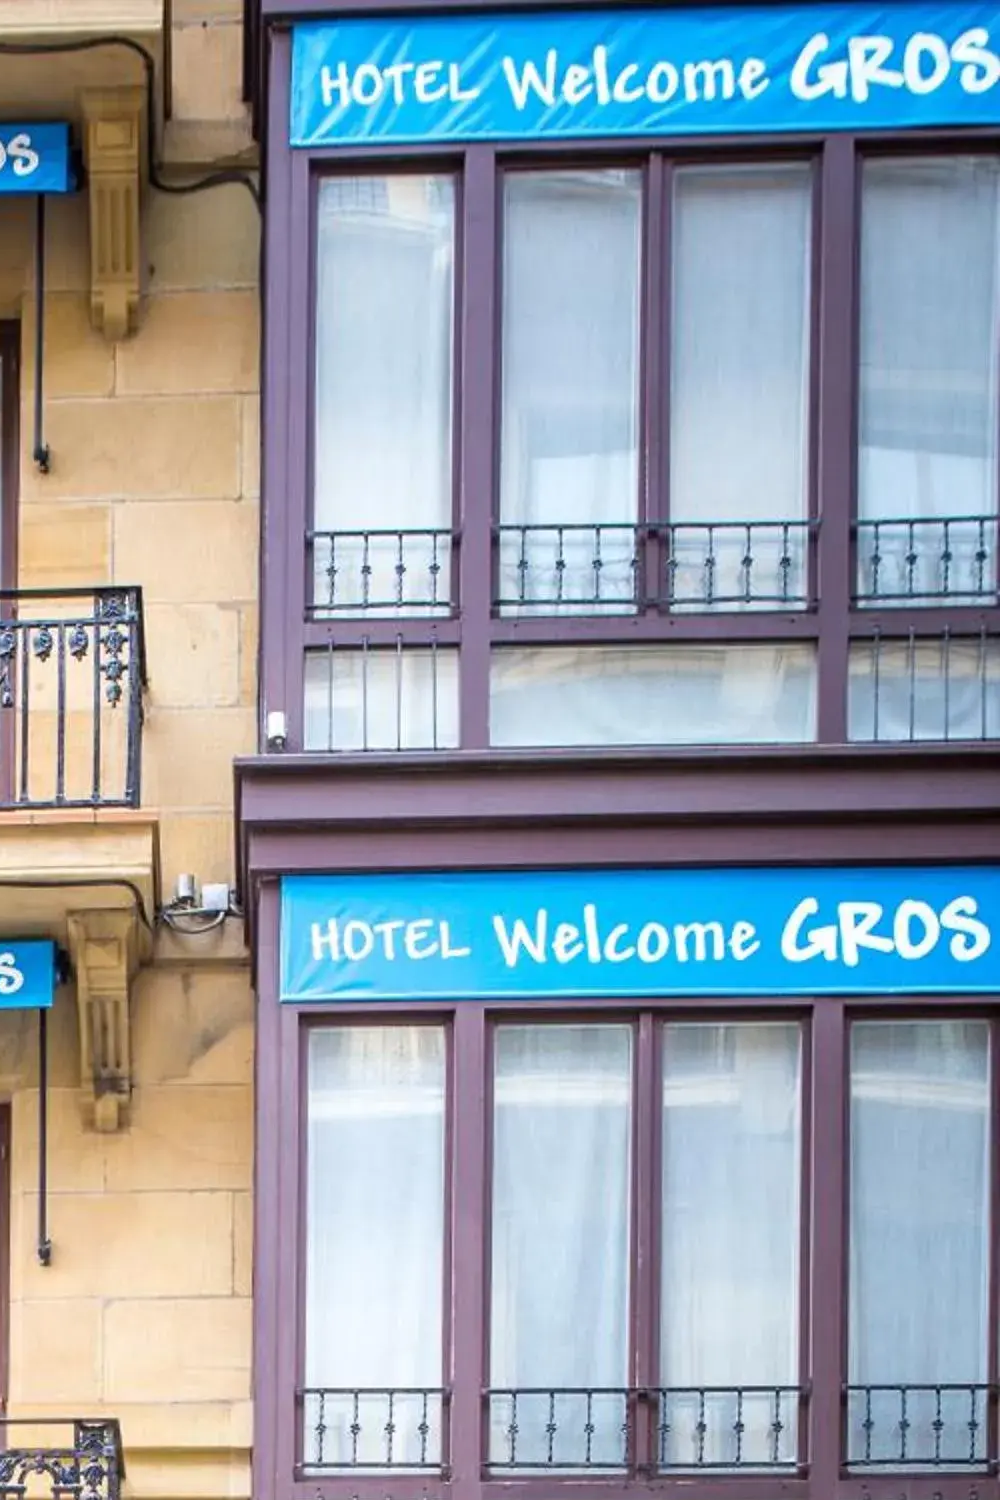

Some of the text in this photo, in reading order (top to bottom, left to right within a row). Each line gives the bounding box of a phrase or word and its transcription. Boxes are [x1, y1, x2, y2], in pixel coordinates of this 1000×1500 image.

[320, 27, 1000, 110] HOTEL Welcome GROS
[310, 895, 991, 967] HOTEL Welcome GROS
